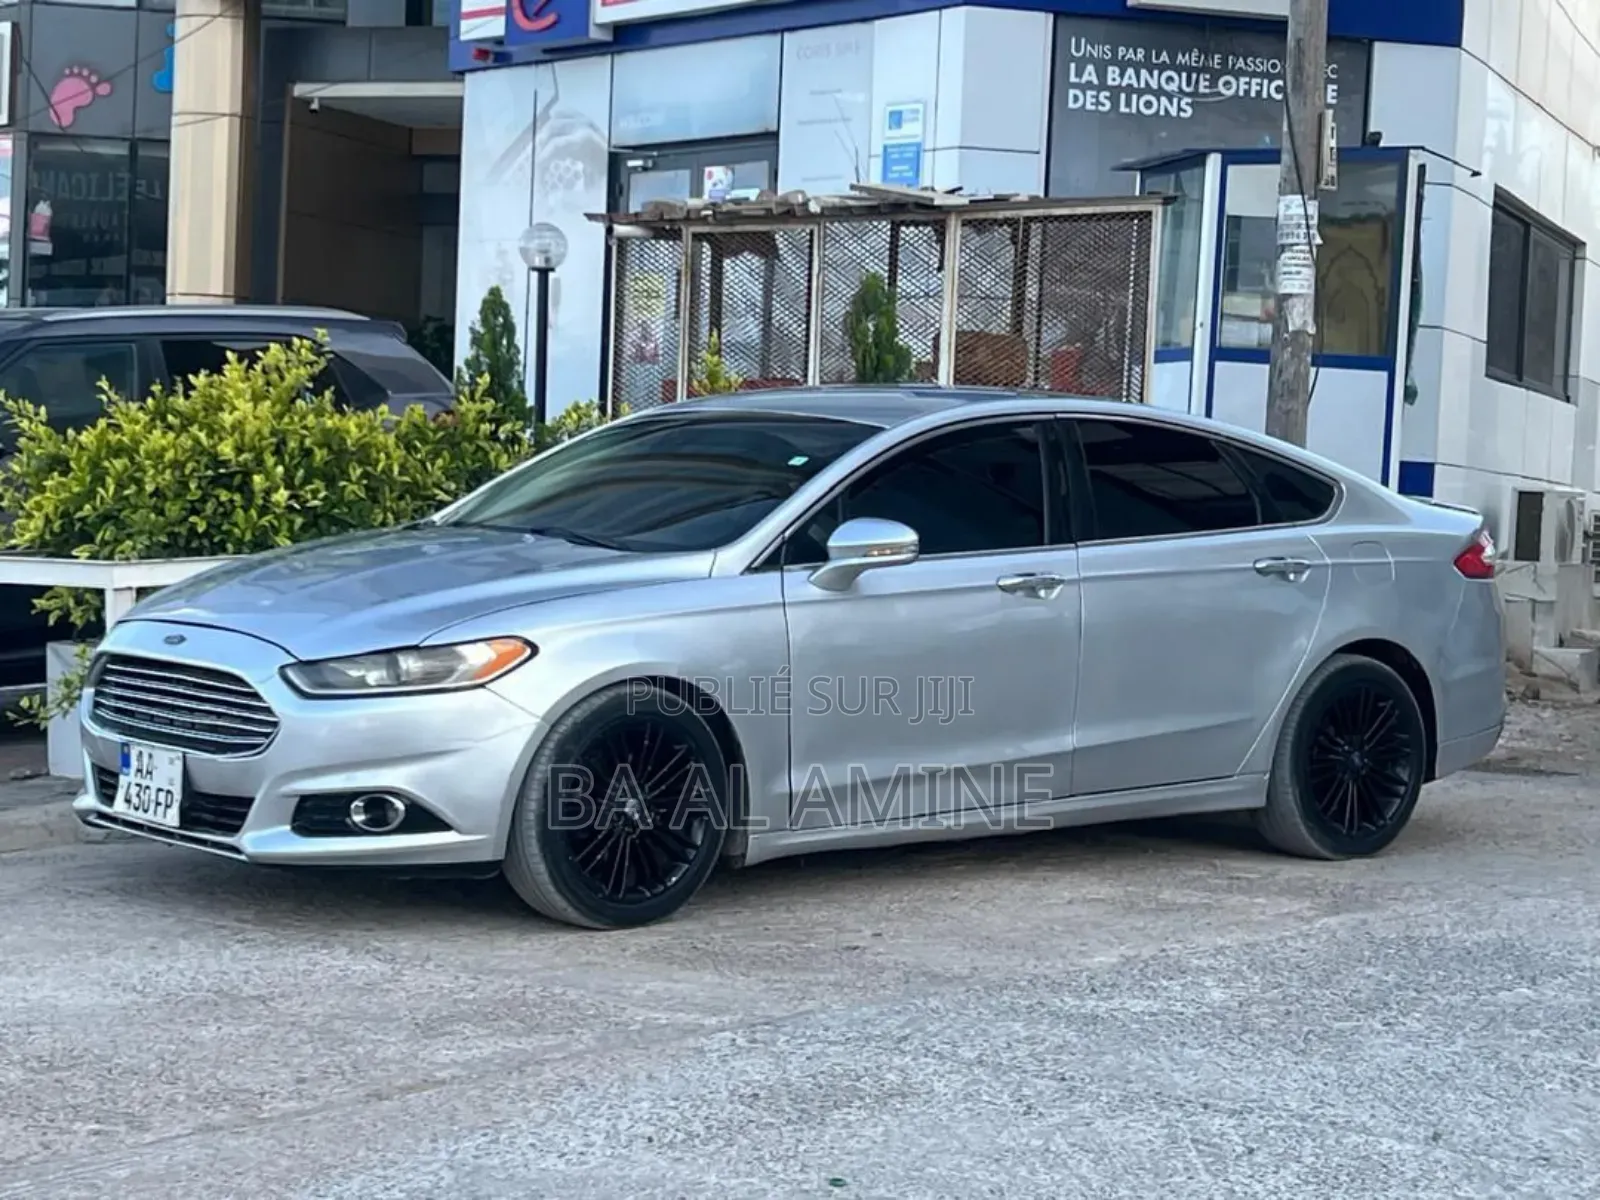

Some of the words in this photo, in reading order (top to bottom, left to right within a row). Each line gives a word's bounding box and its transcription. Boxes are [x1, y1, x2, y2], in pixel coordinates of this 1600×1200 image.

[1118, 46, 1145, 62] PAR
[1152, 48, 1170, 65] LA
[1228, 55, 1284, 74] PASSIO
[1069, 62, 1098, 85] LA
[1106, 65, 1210, 94] BANQUE
[1068, 88, 1111, 112] DES
[1119, 92, 1193, 118] LIONS
